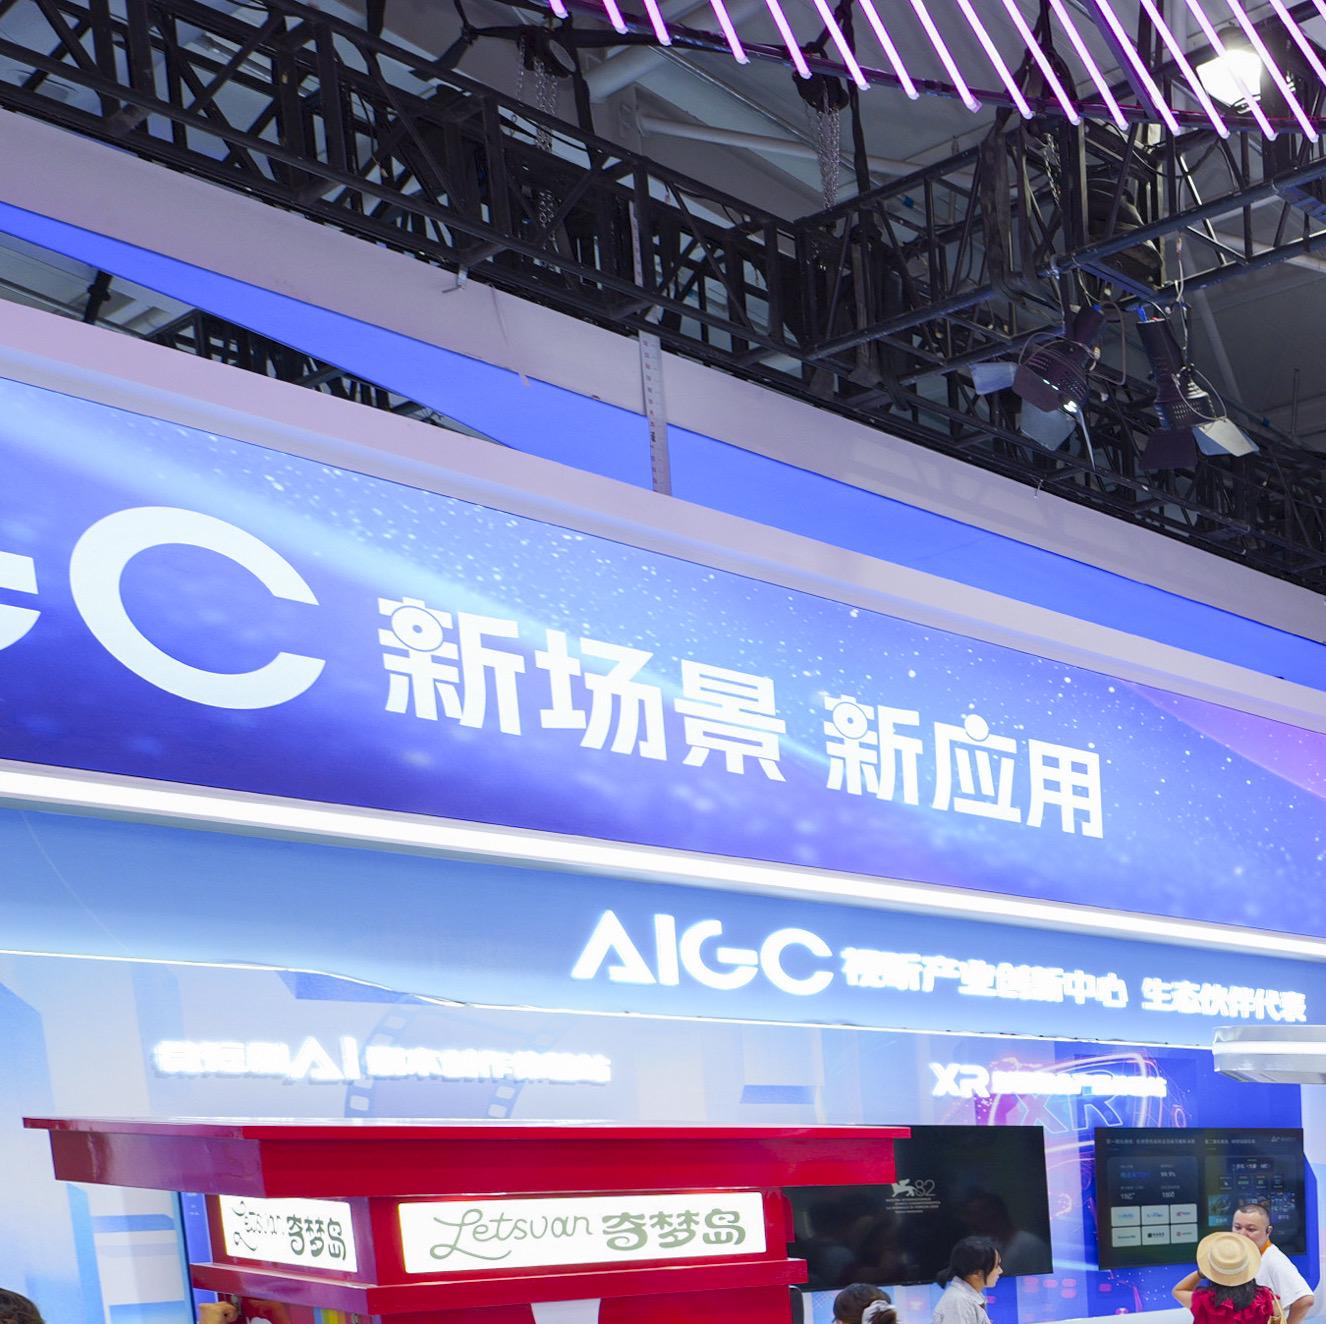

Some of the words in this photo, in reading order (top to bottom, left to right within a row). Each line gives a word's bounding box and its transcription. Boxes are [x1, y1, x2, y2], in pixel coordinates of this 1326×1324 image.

[376, 594, 788, 783] 新场景
[822, 692, 1106, 839] 新应用
[571, 909, 833, 997] AIGC
[286, 1213, 346, 1261] 奇梦岛
[602, 1207, 747, 1250] 奇梦岛
